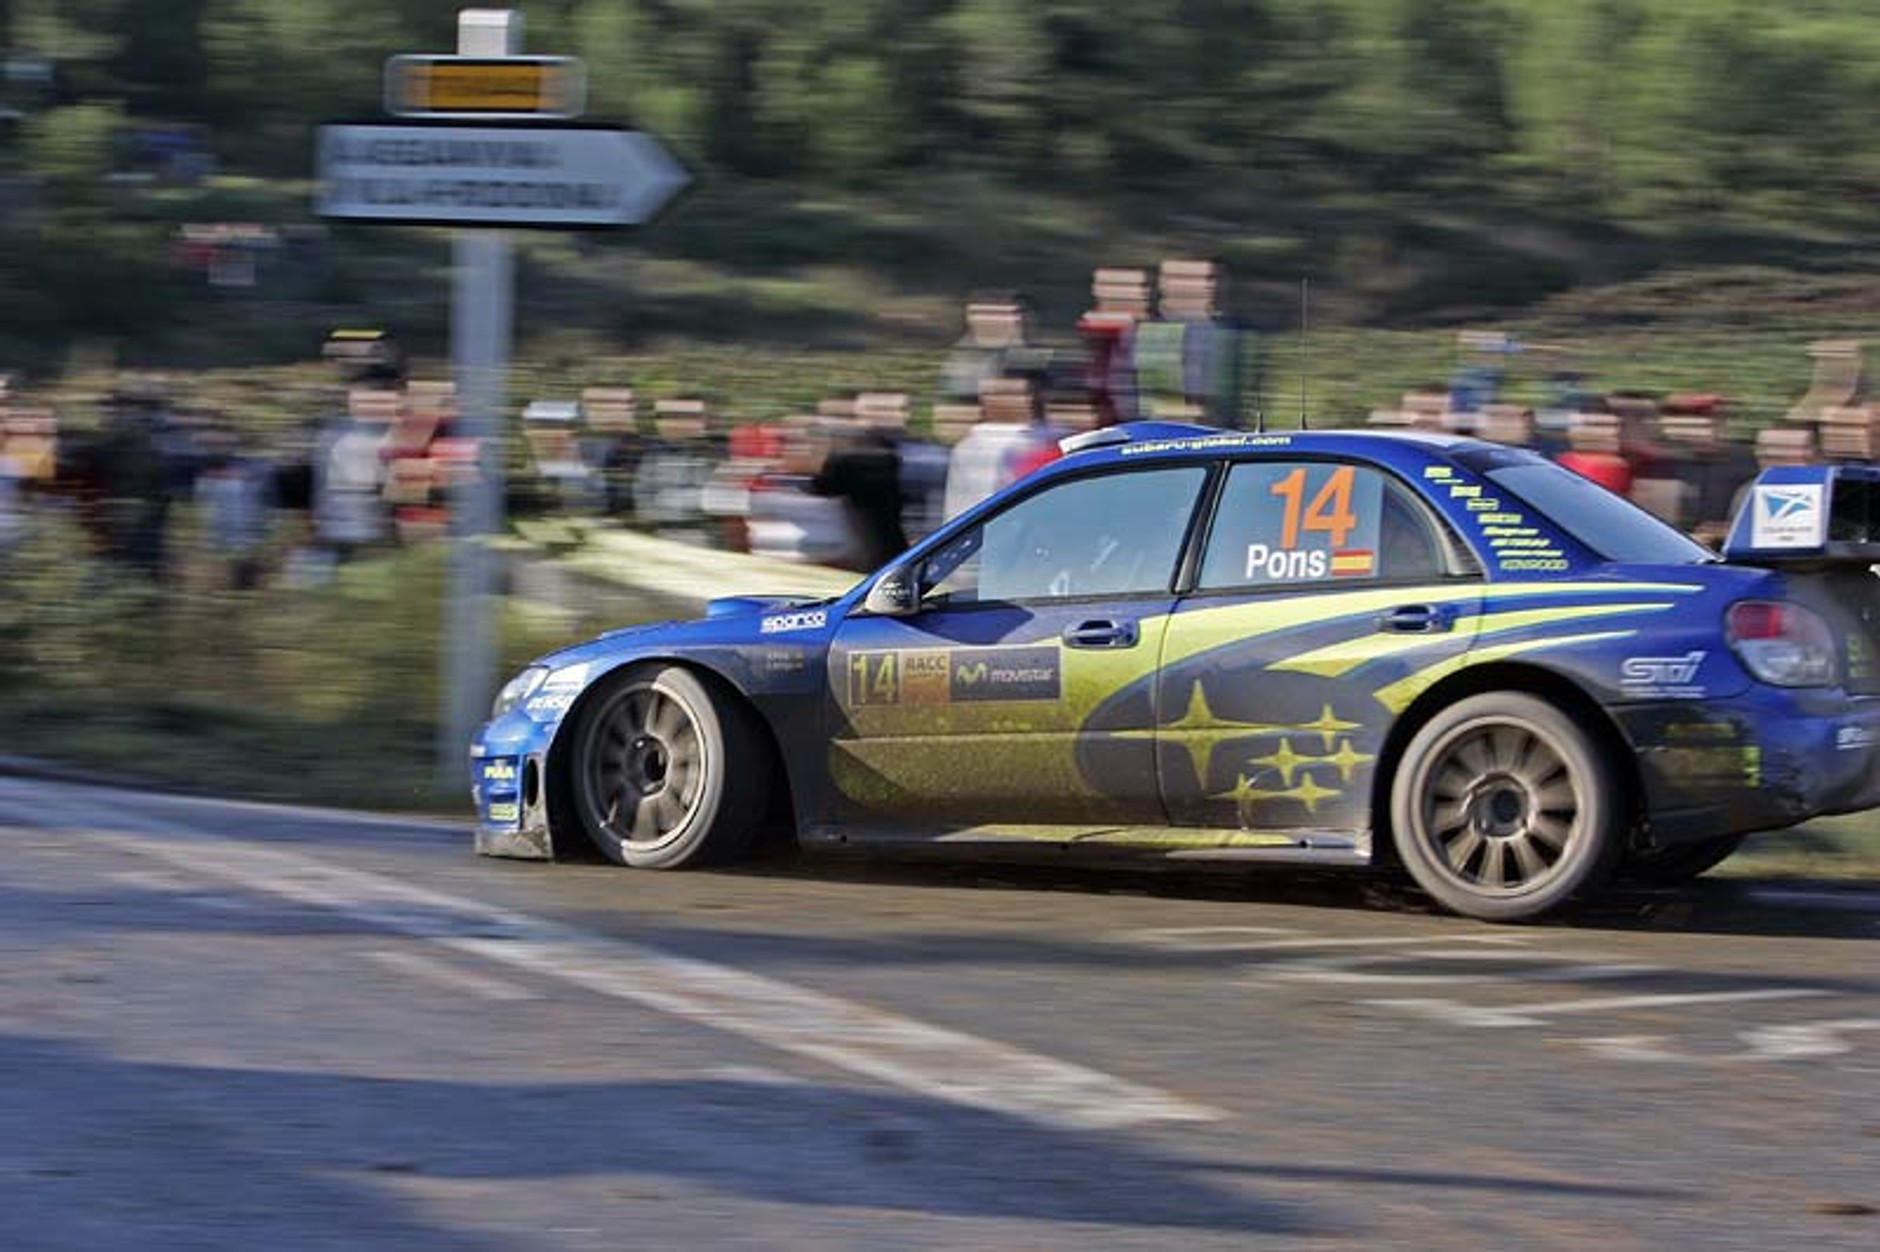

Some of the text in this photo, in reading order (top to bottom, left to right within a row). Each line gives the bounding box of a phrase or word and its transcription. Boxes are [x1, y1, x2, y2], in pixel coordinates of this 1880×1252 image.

[1270, 466, 1356, 549] 14
[1246, 544, 1327, 578] Pons
[761, 611, 828, 633] sparco
[853, 654, 896, 704] 14
